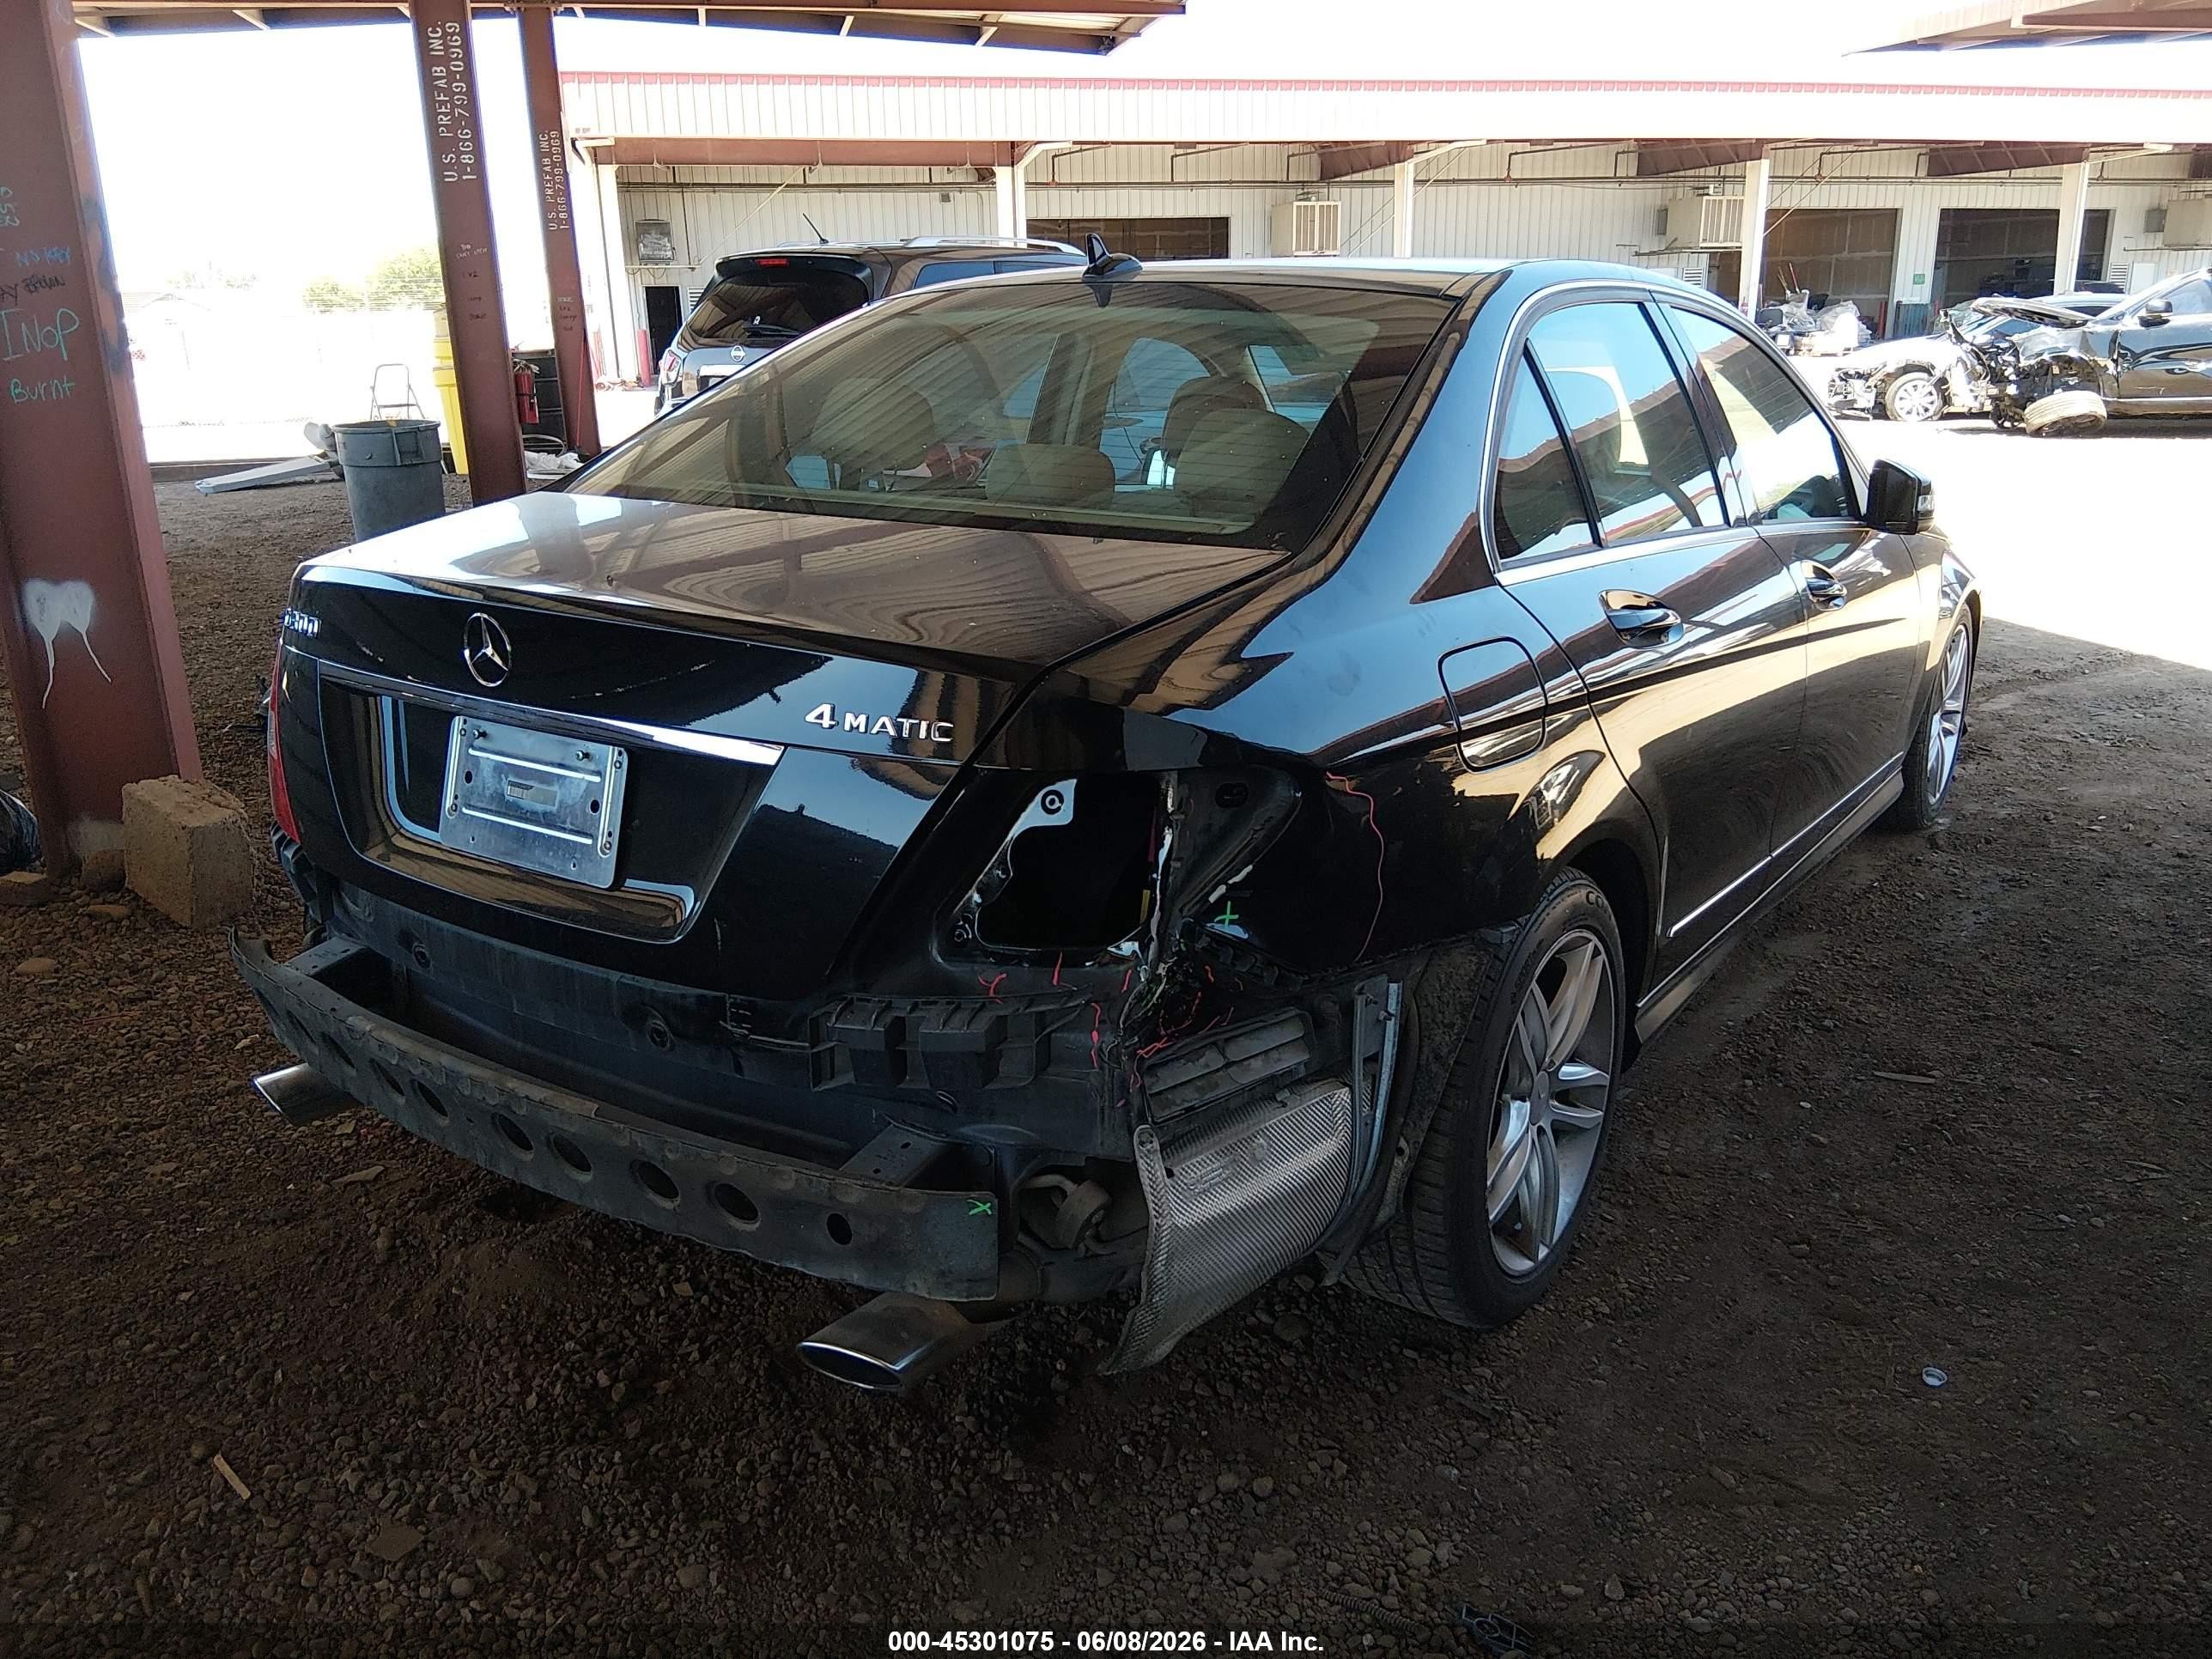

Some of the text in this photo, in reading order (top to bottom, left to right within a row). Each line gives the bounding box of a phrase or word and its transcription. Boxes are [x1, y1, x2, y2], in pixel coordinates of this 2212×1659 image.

[427, 21, 459, 182] U.S. PREFAB INC.
[445, 21, 477, 181] 1-866-799-0969
[538, 130, 558, 231] U.S. PREFAB INC.
[550, 131, 569, 230] 1-866-799-0969
[9, 376, 76, 404] Burnt
